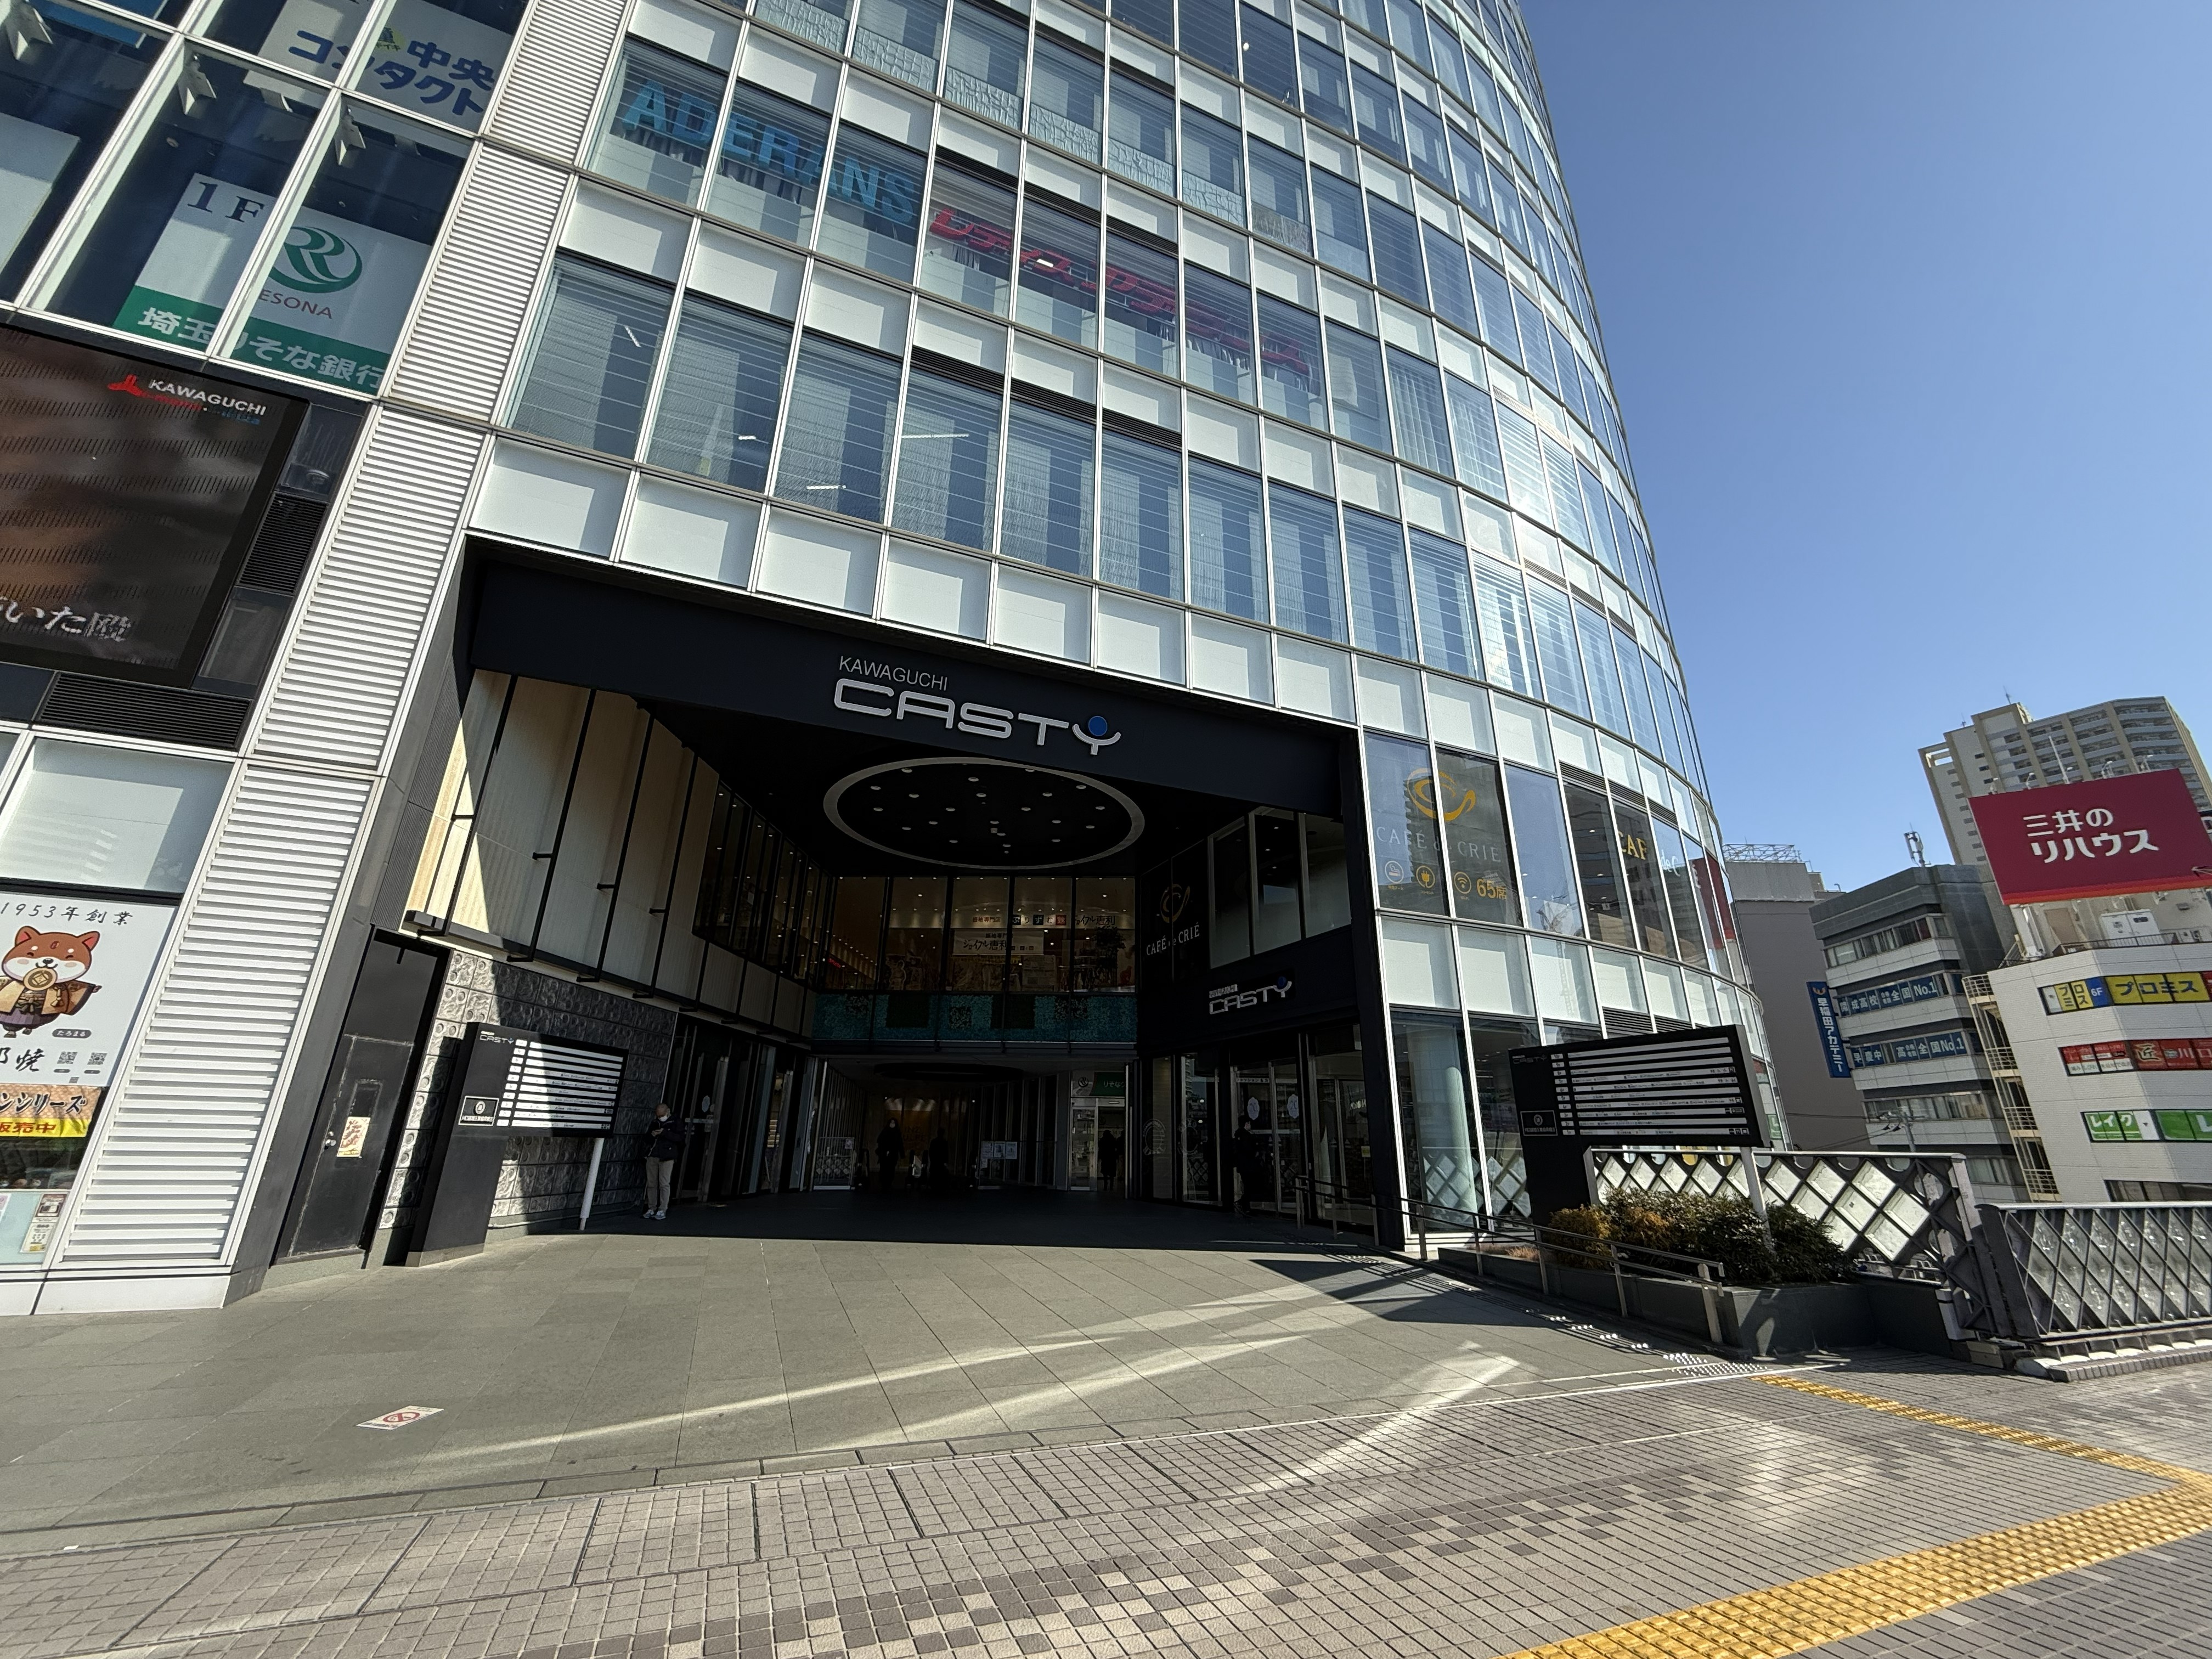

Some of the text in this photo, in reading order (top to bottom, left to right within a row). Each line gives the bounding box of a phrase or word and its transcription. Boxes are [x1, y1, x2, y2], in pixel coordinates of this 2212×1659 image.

[407, 40, 494, 91] 中央
[622, 79, 916, 224] ADERANS
[188, 180, 266, 223] 1F
[258, 289, 333, 319] ESONA
[149, 379, 267, 416] KAWAGUCHI
[839, 656, 949, 691] KAWAGUCHI
[834, 678, 1121, 755] CASTY
[2023, 808, 2113, 837] 三井の
[2030, 829, 2160, 864] リハウス
[0, 902, 133, 926] 1953年創業
[1075, 915, 1115, 926] ョイフル恵利
[1146, 935, 1167, 956] CAFÉ
[1178, 922, 1200, 944] CRIÉ
[1209, 978, 1293, 1015] CASTY
[2091, 988, 2103, 997] 6F
[2115, 981, 2199, 996] プロミス
[1816, 997, 1843, 1073] 早稲田アカデミー
[2090, 1114, 2132, 1127] レイク
